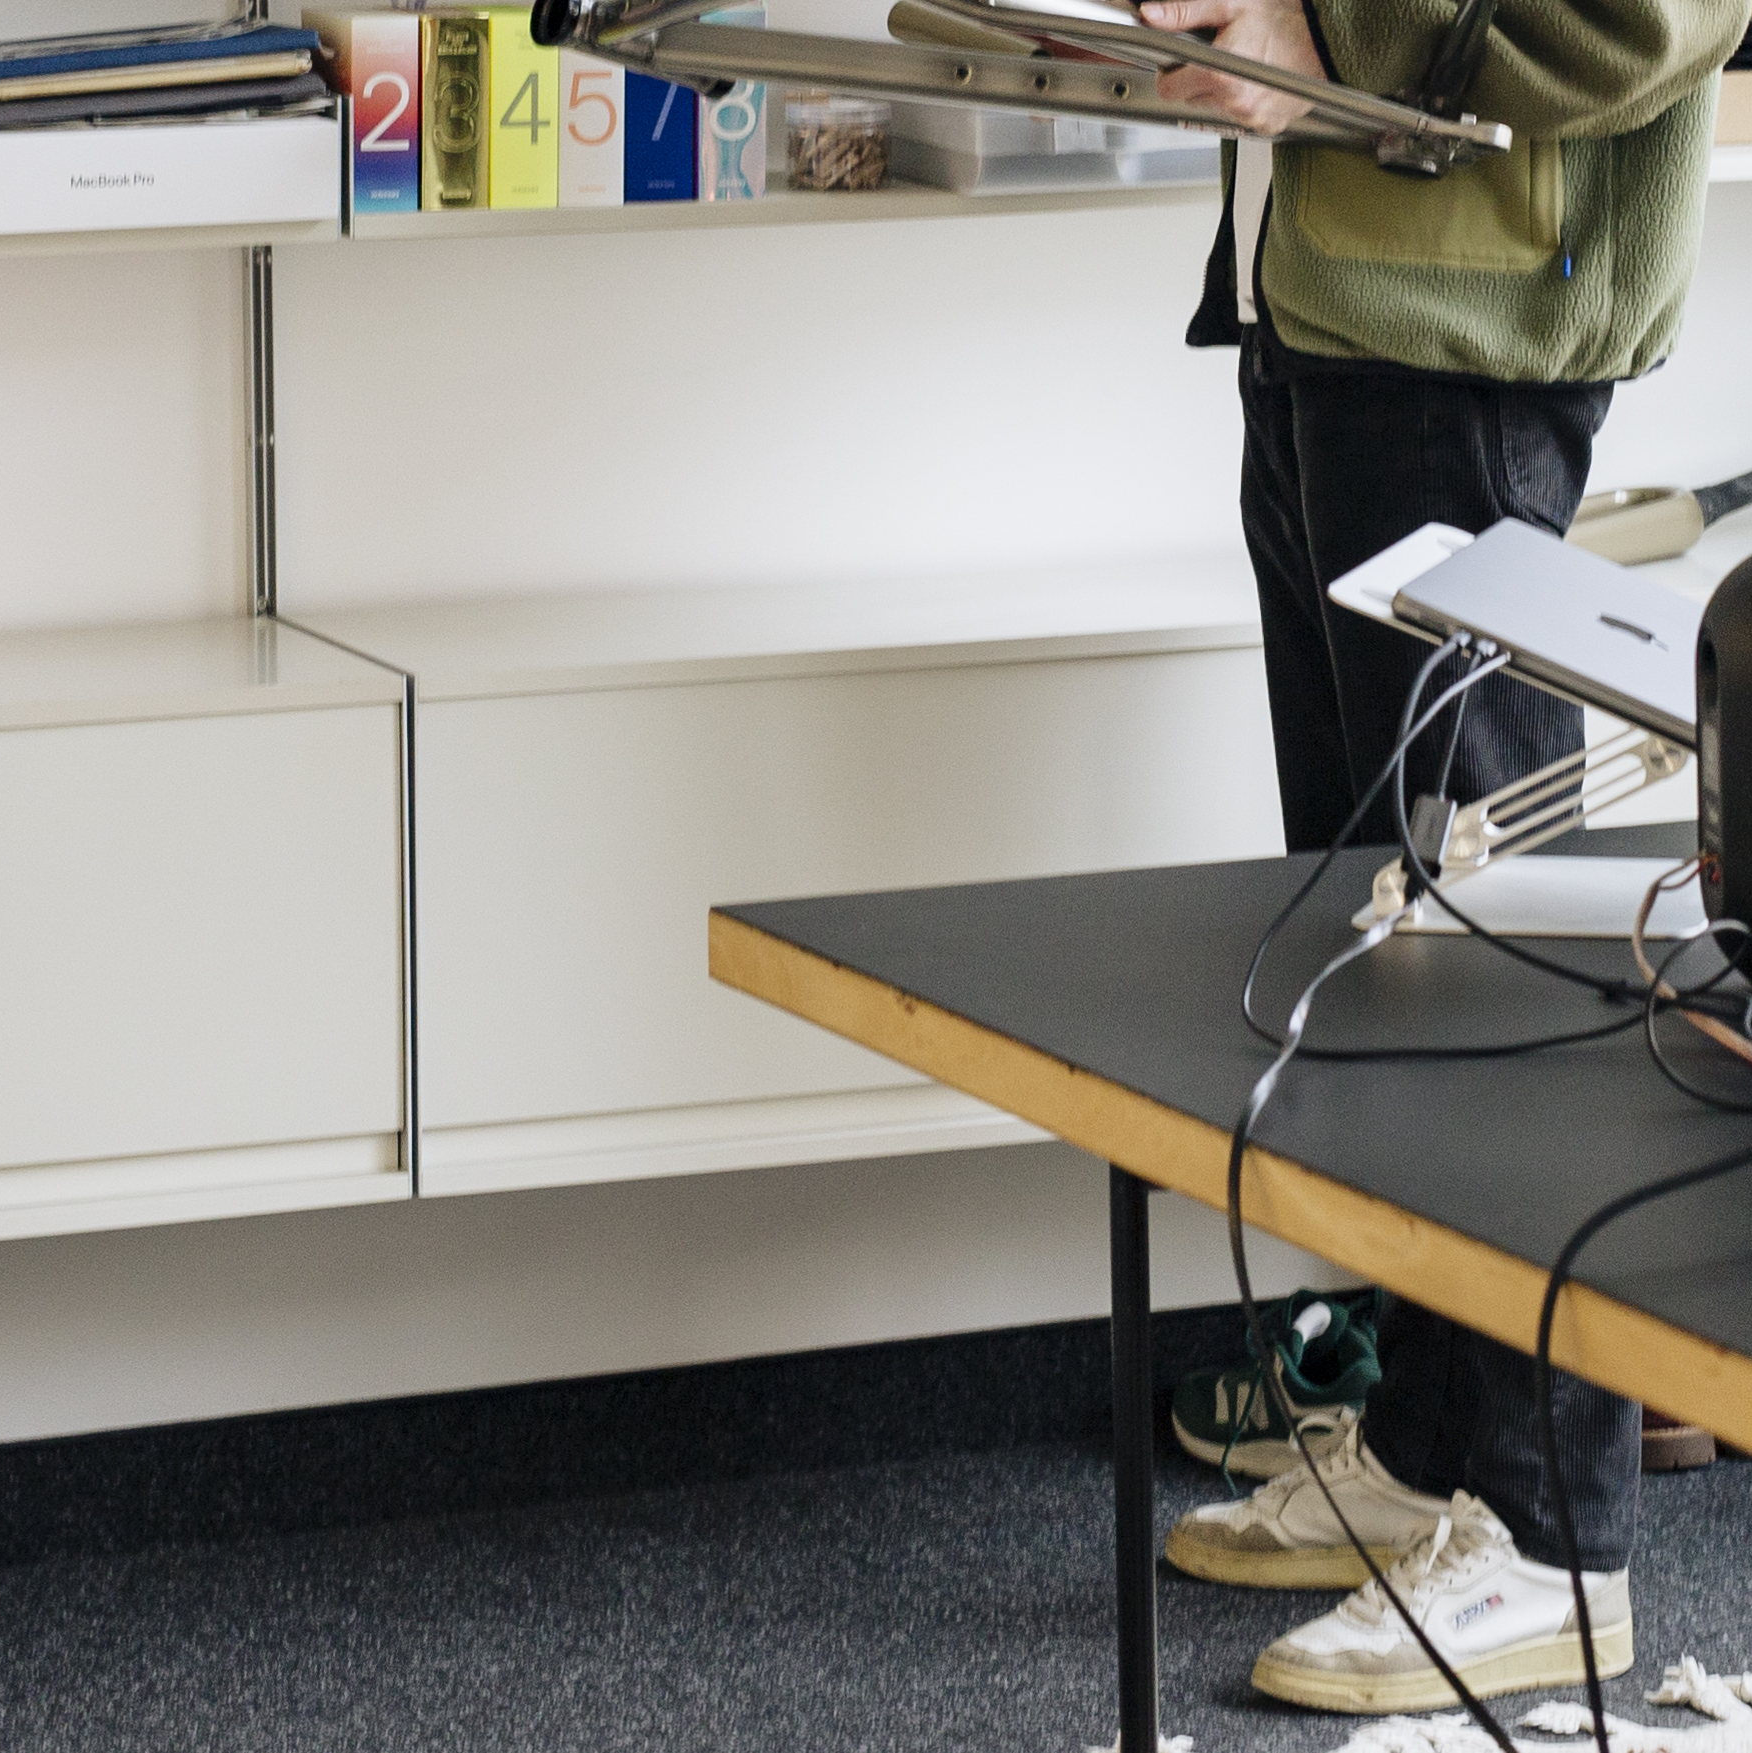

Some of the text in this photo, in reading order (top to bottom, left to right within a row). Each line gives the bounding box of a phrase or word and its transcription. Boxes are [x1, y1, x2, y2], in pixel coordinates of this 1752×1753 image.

[360, 71, 410, 152] 2
[499, 71, 551, 146] 4
[567, 70, 617, 146] 5
[70, 172, 155, 190] MacBook Pro
